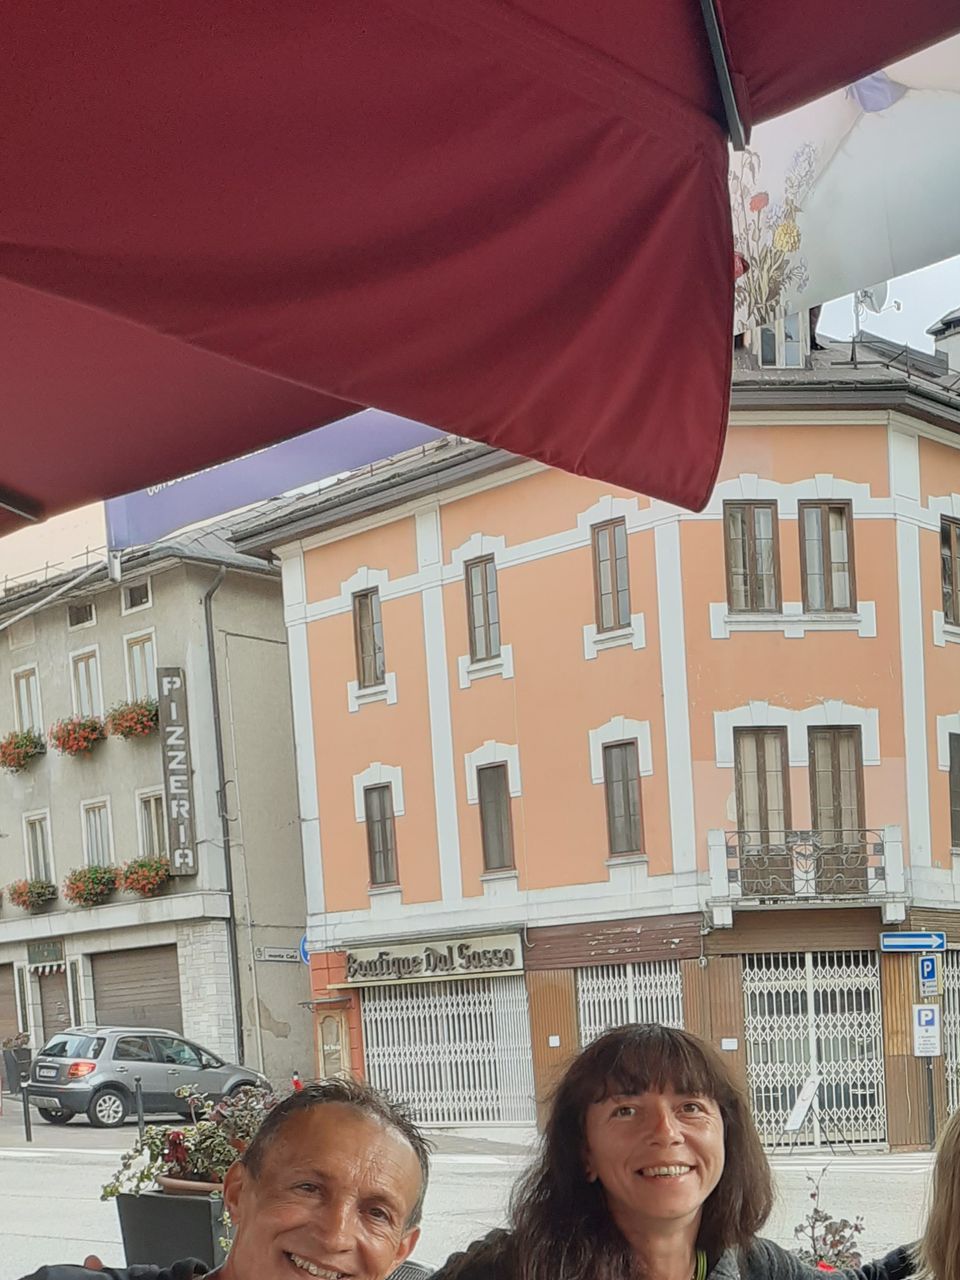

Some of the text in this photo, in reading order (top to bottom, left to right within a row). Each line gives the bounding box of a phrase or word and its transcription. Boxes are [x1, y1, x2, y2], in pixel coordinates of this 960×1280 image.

[161, 676, 195, 869] PIZZERIA
[345, 943, 516, 980] Boutique Dal Sasso
